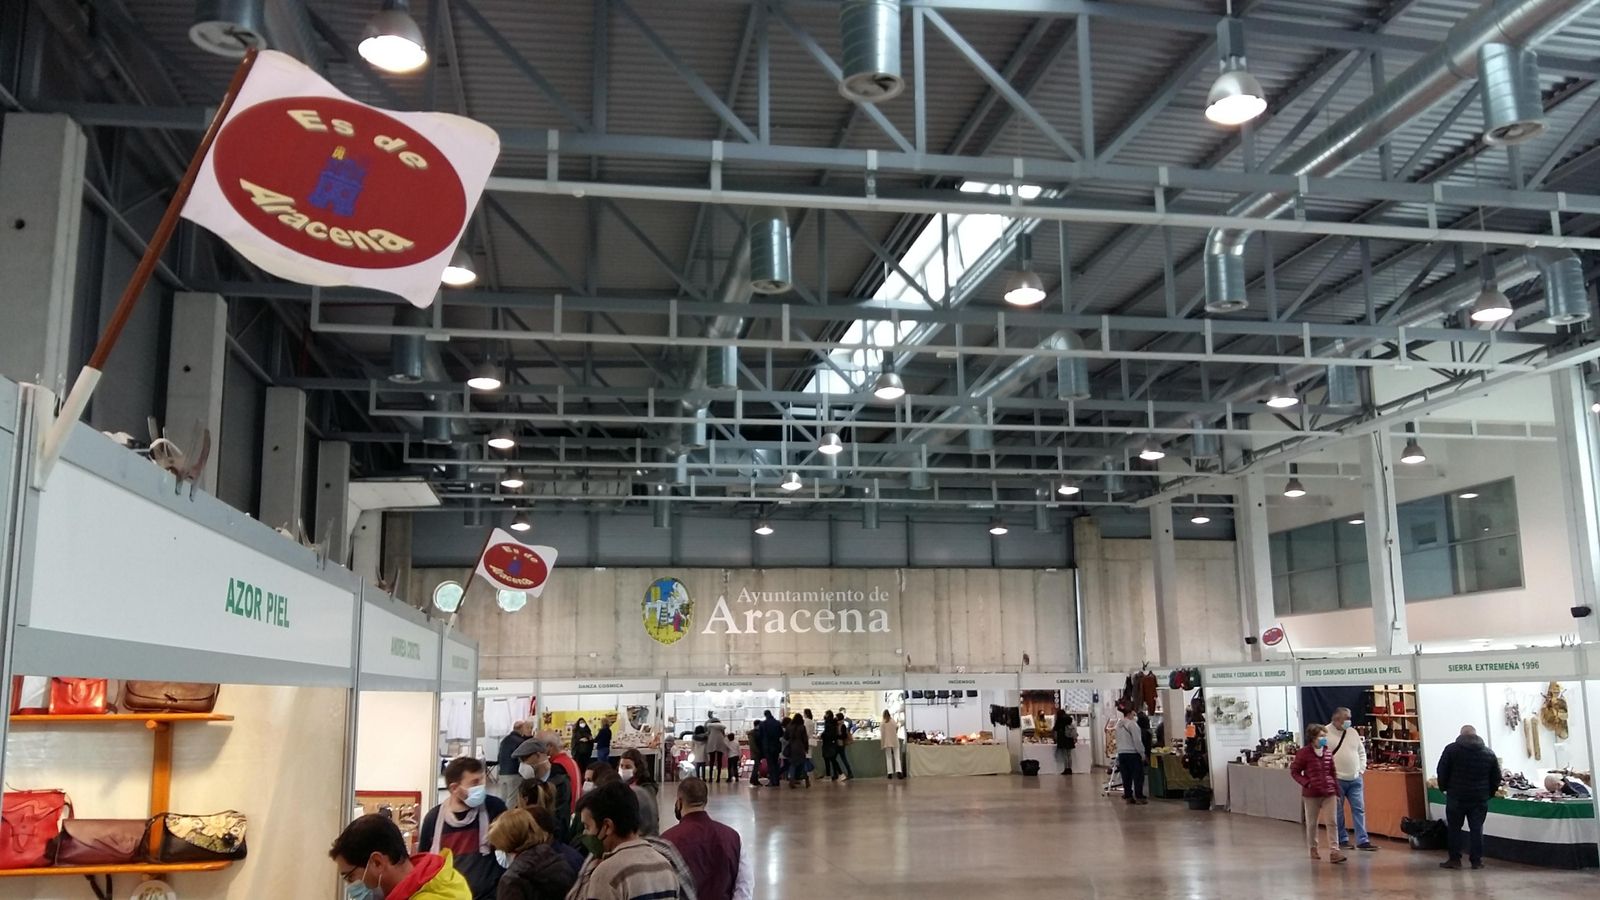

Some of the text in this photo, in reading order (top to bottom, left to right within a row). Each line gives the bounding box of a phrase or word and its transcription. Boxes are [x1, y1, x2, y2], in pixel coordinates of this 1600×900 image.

[287, 110, 429, 170] Es de
[239, 178, 415, 253] Aracena
[502, 545, 538, 563] Es de
[489, 564, 534, 585] Aracena
[225, 577, 289, 628] AZOR PIEL
[737, 586, 889, 605] Ayuntamiento de
[702, 595, 891, 634] Aracena
[1448, 661, 1540, 672] SIERRA EXTREMEÑA 1996
